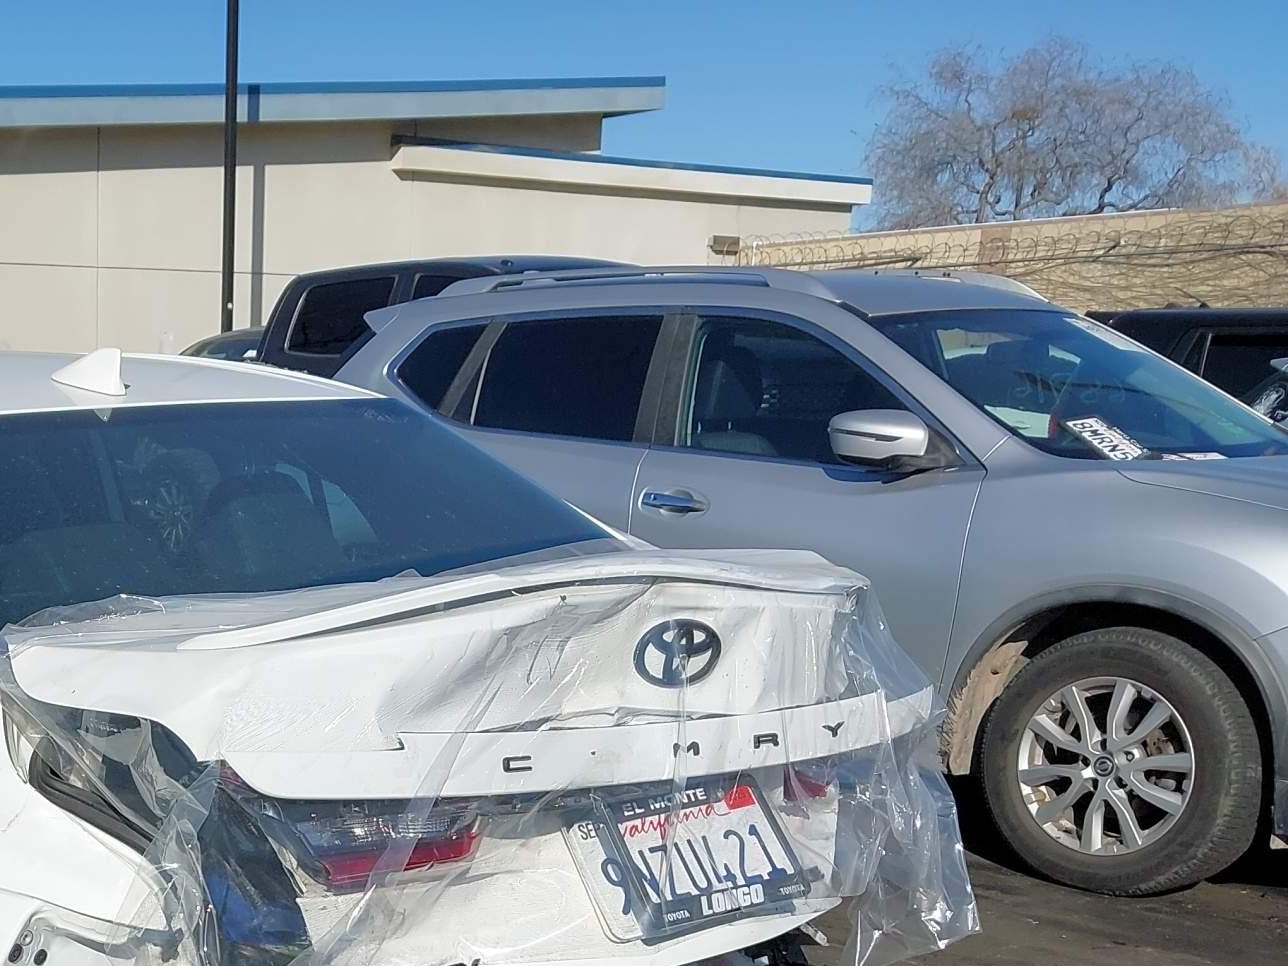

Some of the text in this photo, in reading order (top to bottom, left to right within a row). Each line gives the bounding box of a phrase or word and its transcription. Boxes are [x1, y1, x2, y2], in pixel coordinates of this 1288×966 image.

[503, 721, 845, 774] CMRY
[623, 788, 707, 816] EL MONTE
[700, 884, 765, 916] LONGO
